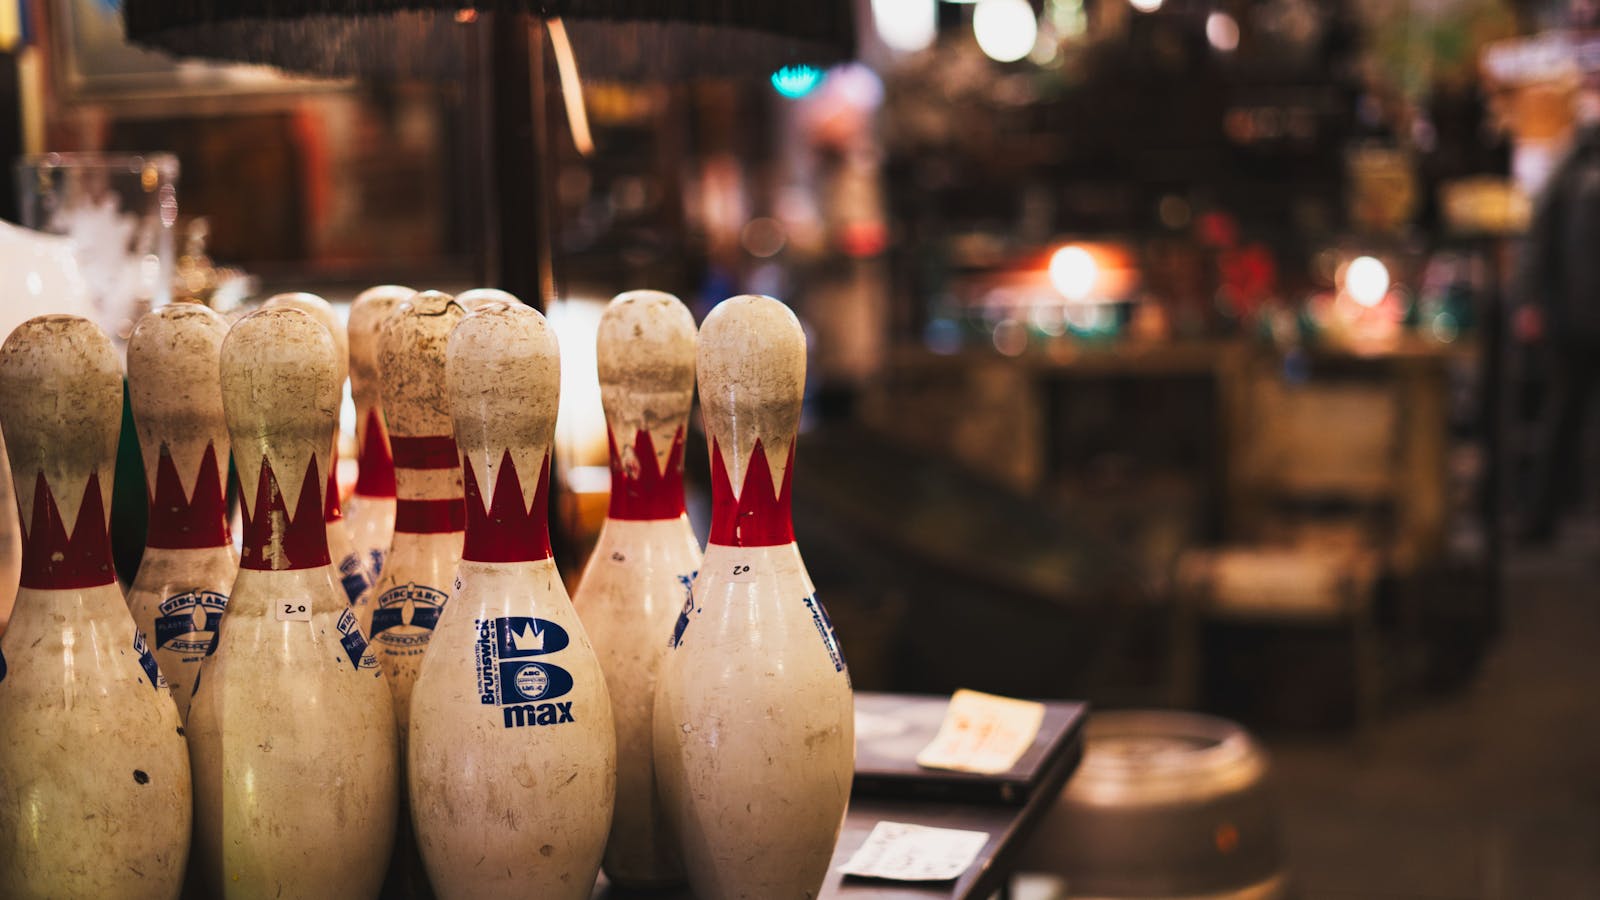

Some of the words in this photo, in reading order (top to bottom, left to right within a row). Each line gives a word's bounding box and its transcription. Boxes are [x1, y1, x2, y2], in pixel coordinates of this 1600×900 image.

[733, 565, 750, 576] 20
[284, 603, 306, 614] 20
[475, 619, 495, 705] Brunswick
[503, 701, 575, 728] max
